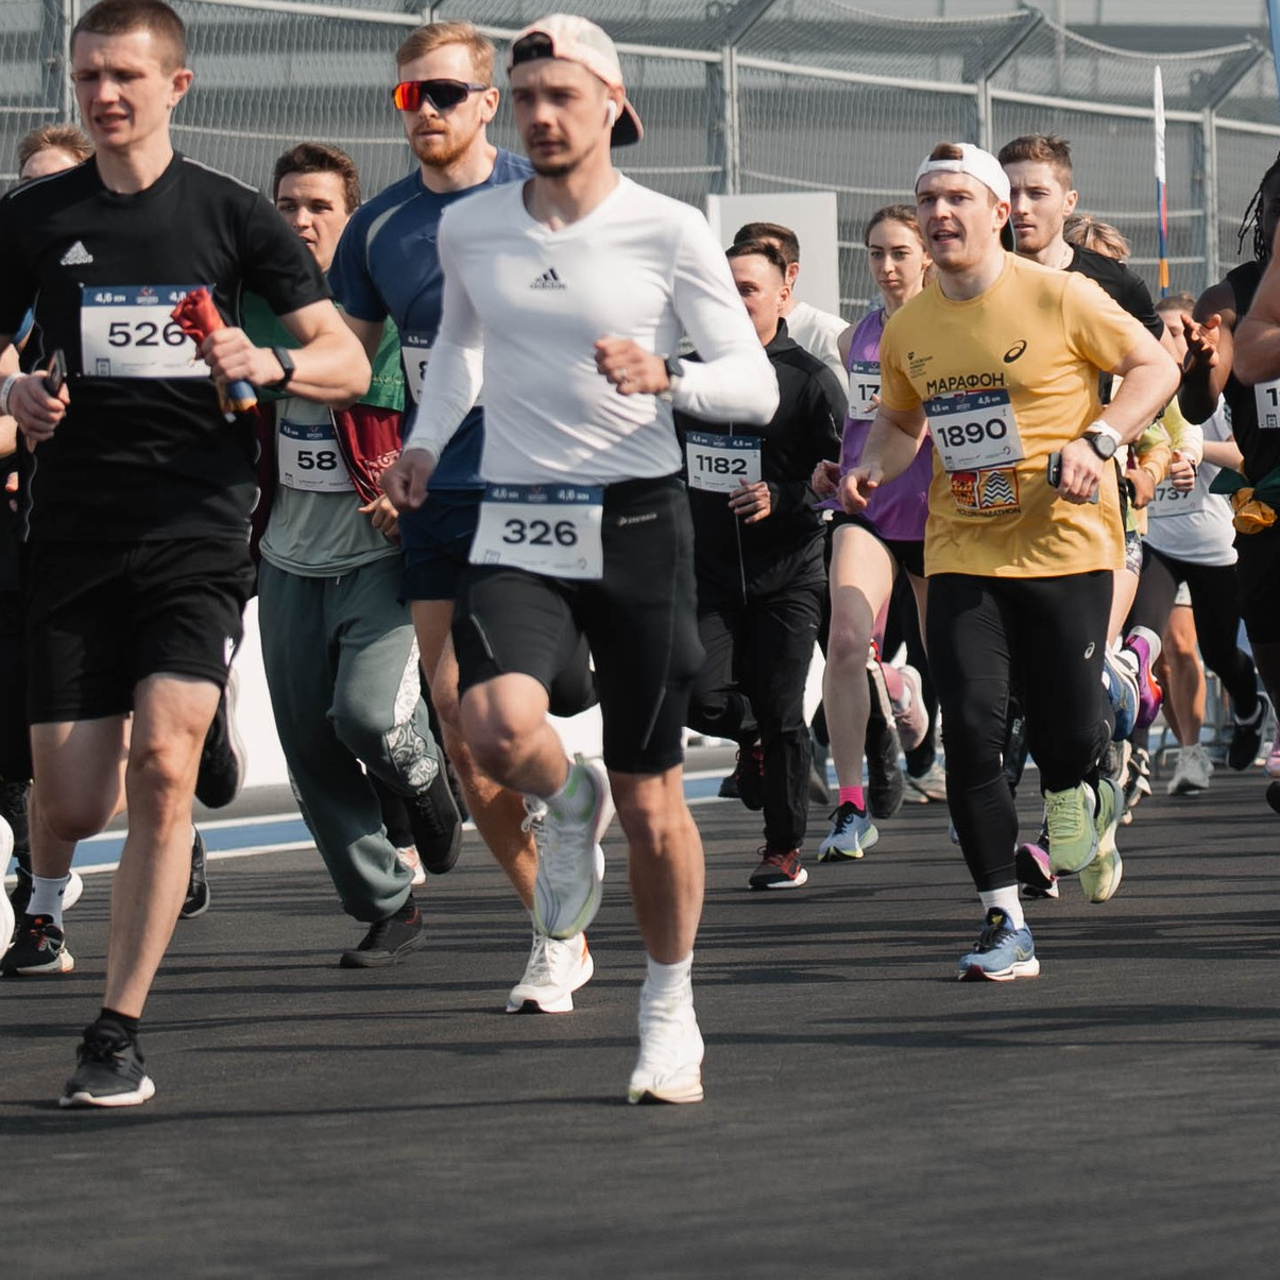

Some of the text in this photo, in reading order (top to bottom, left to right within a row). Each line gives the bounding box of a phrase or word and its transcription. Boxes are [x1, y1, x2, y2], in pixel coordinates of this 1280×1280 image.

[108, 321, 187, 347] 526
[926, 372, 1005, 395] МАРАФОН
[937, 418, 1007, 448] 1890
[297, 450, 338, 471] 58
[696, 454, 748, 475] 1182
[502, 518, 579, 547] 326
